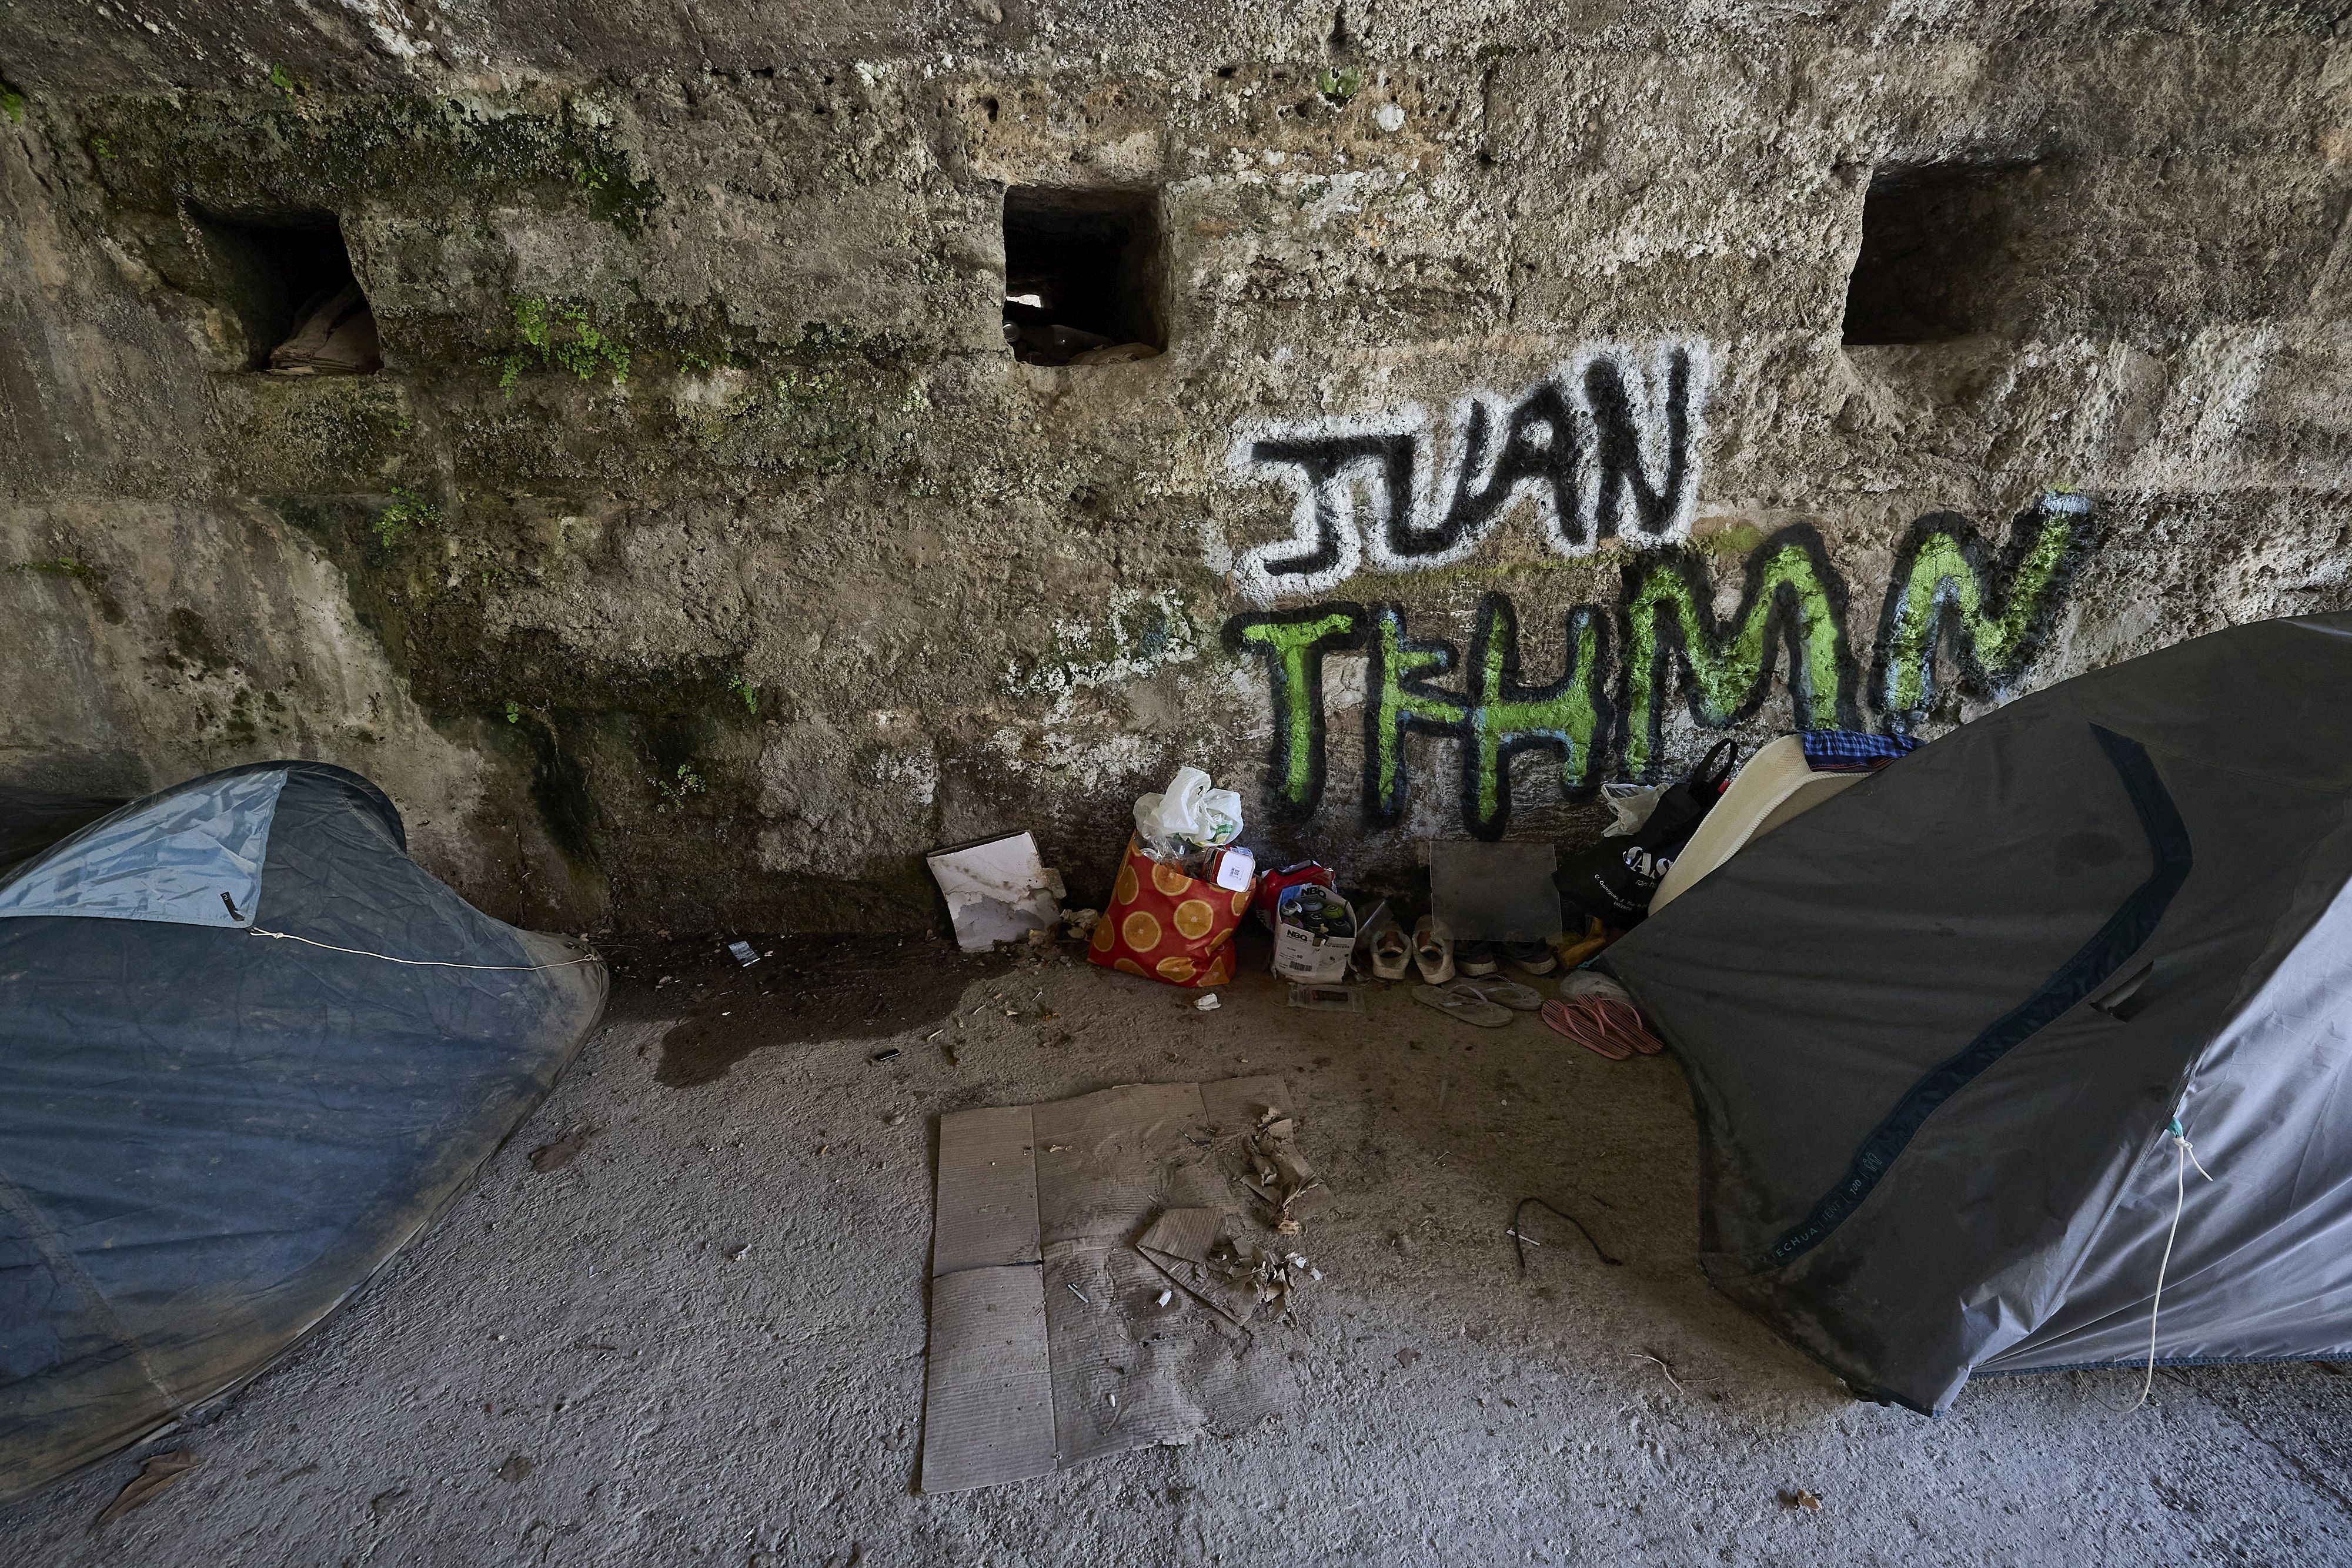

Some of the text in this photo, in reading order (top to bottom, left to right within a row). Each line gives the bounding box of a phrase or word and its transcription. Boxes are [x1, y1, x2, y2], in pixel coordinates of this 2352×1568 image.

[1238, 338, 1704, 591] JUAN
[1822, 1201, 1841, 1221] TENT
[1849, 1179, 1862, 1195] 100
